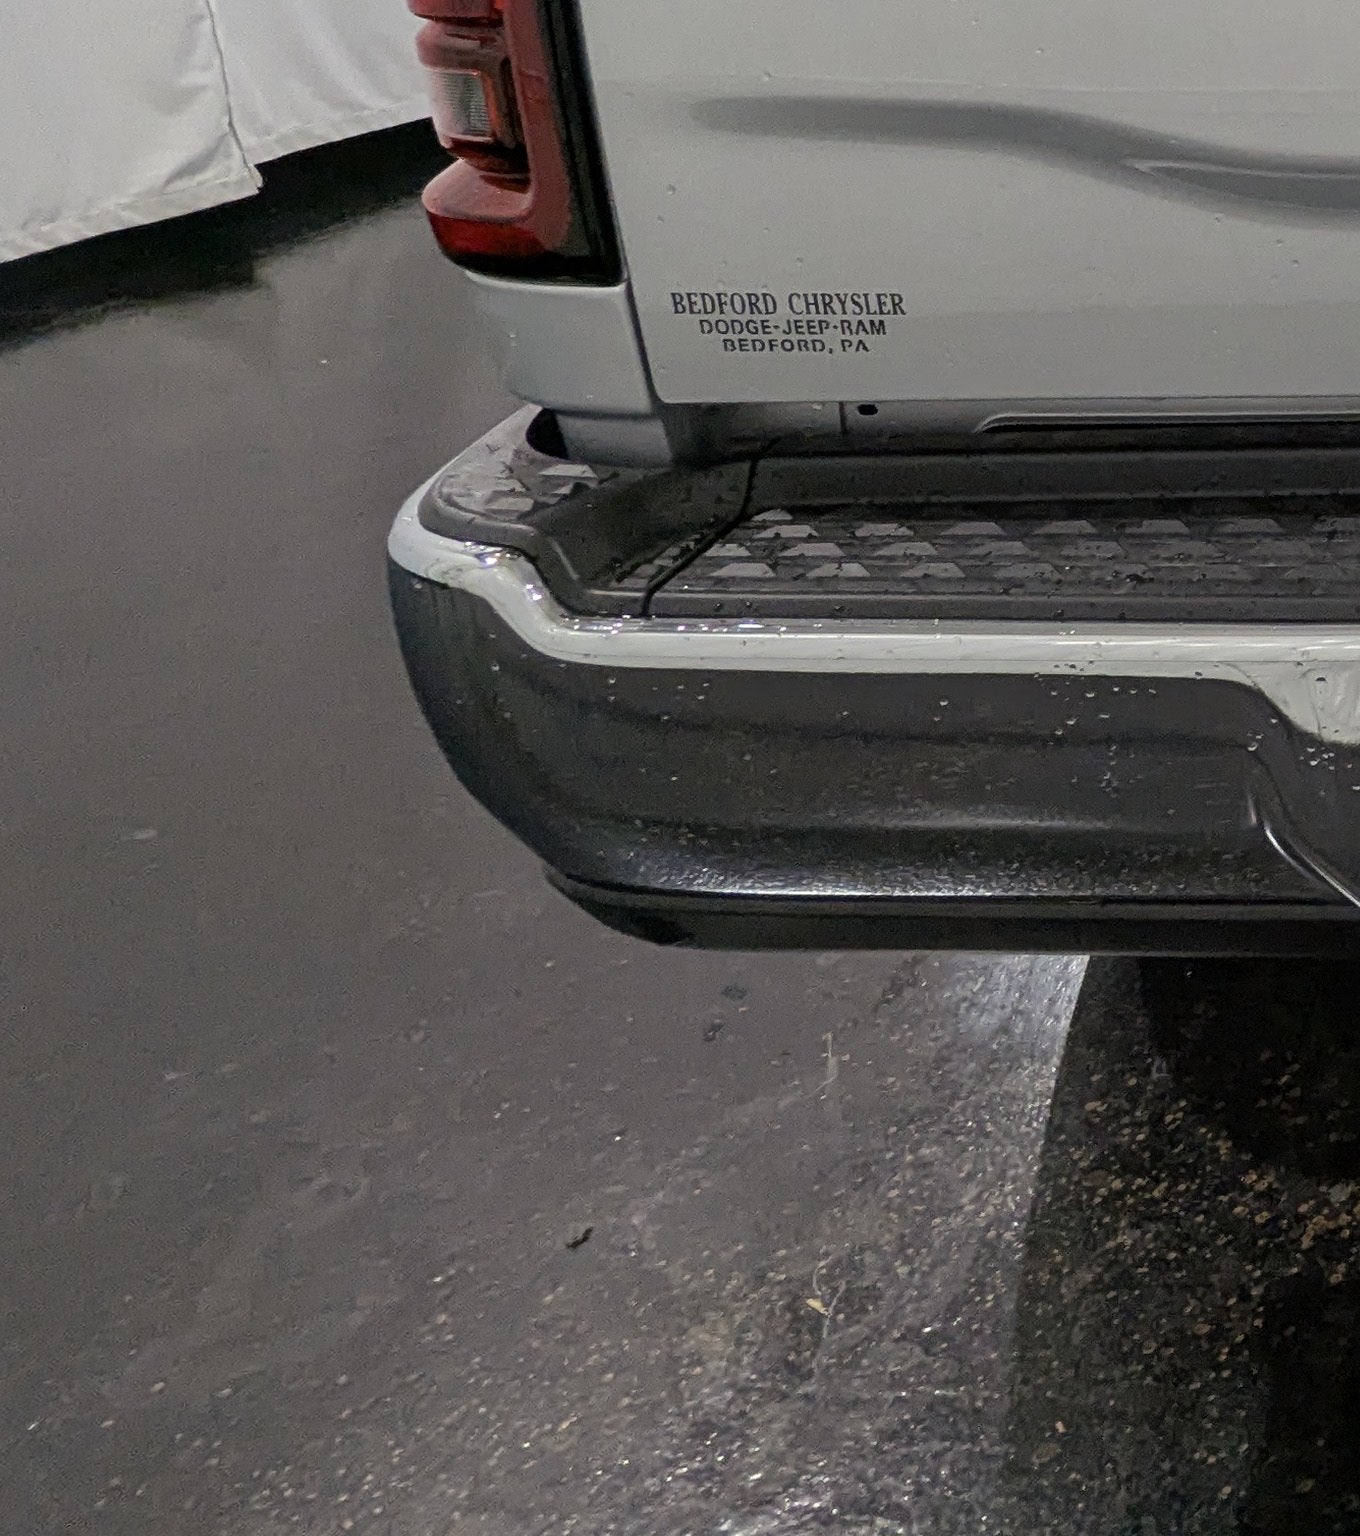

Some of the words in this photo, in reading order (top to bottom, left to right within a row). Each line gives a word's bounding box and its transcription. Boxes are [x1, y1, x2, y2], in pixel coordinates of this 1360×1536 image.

[670, 292, 777, 315] BEDFORD
[787, 292, 907, 316] CHRYSLER
[841, 338, 870, 353] PA
